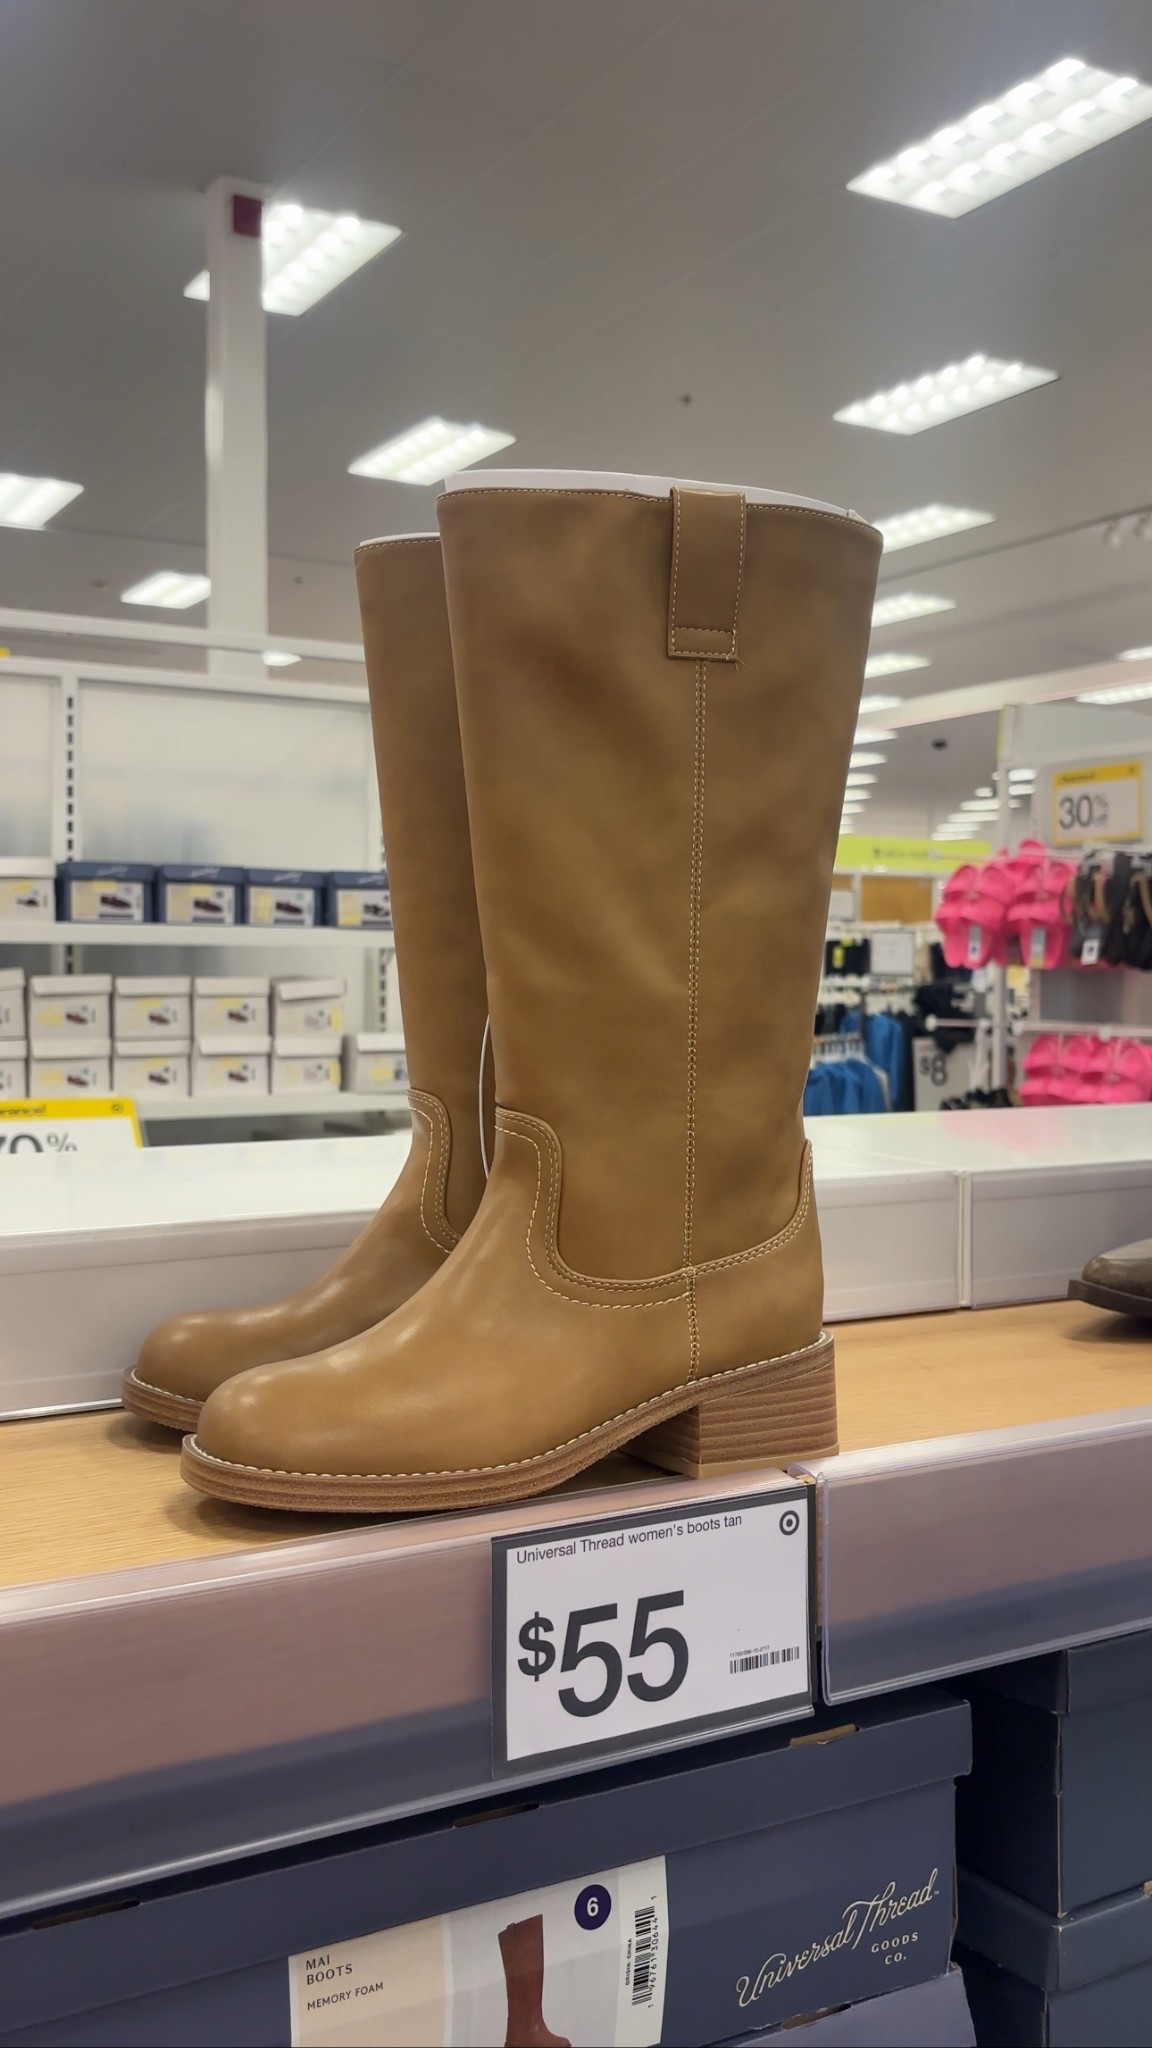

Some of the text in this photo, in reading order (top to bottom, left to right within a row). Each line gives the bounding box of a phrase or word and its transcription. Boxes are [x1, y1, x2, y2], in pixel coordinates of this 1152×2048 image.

[517, 1514, 742, 1564] Universal Thread women's boots tan
[517, 1590, 689, 1717] $55
[587, 1896, 599, 1917] 6
[736, 1867, 938, 2007] Universal Thread
[871, 1932, 918, 1953] GOODS
[306, 1954, 330, 1970] MAI
[884, 1952, 906, 1965] CO.
[306, 1963, 352, 1985] BOOTS
[307, 1982, 383, 2010] MEMORY FOAM
